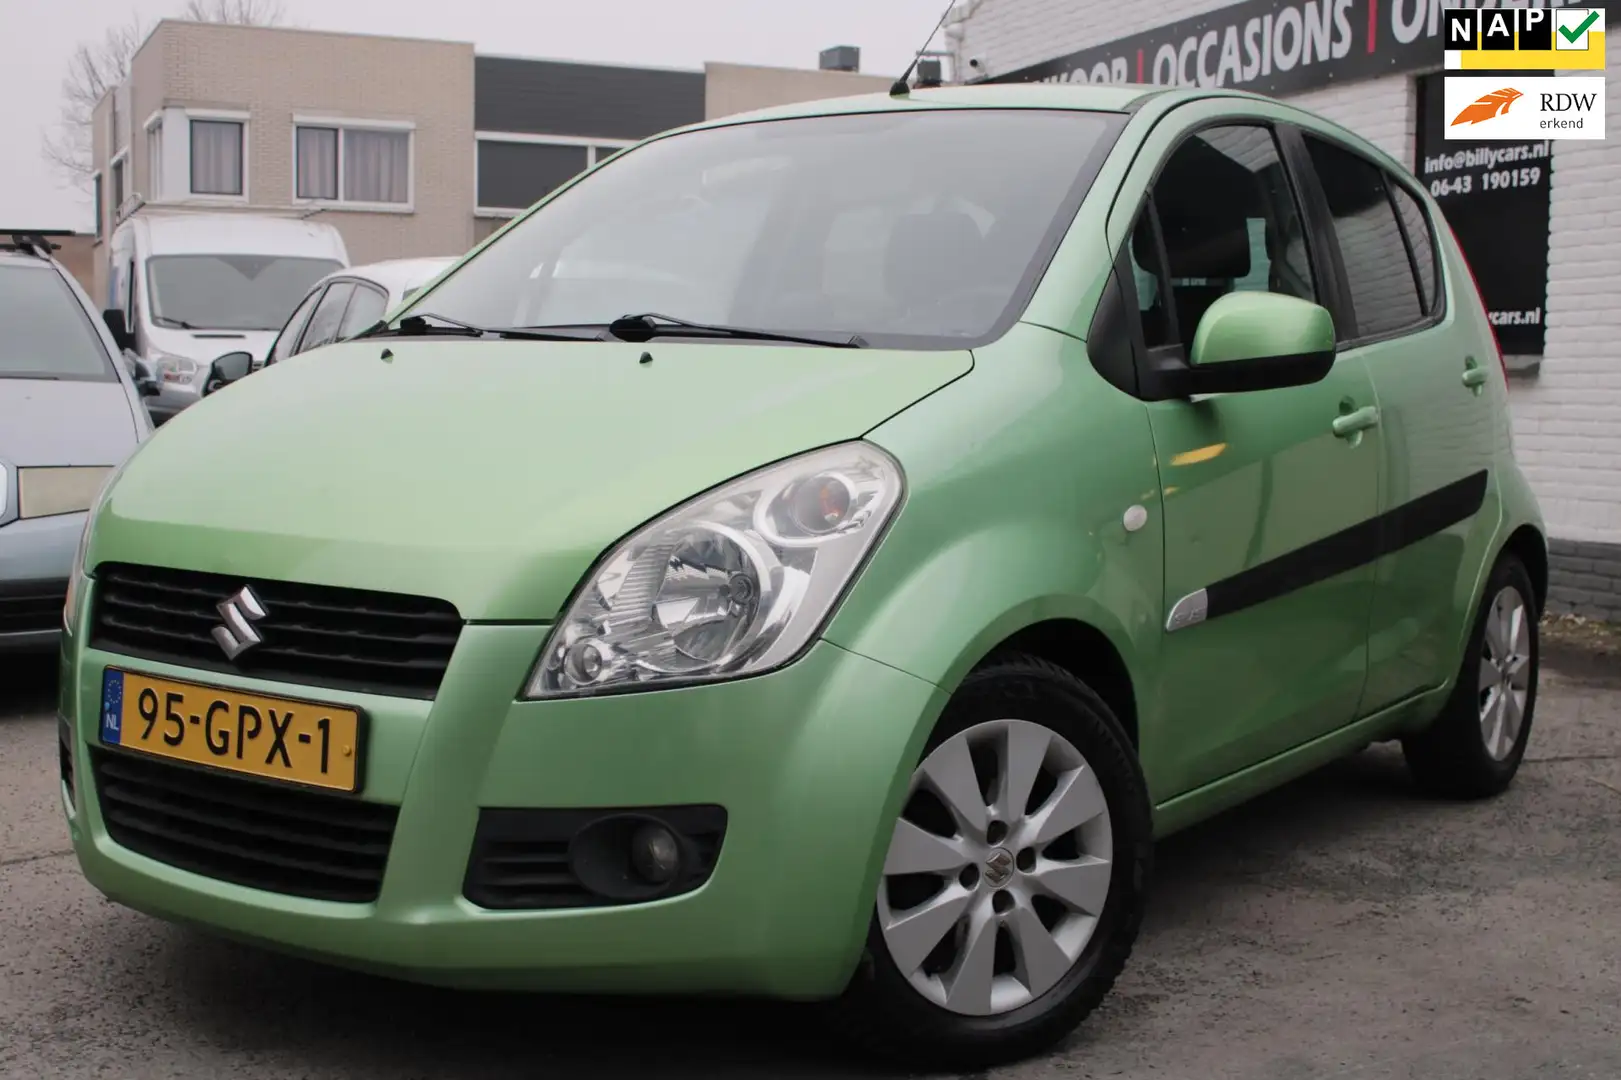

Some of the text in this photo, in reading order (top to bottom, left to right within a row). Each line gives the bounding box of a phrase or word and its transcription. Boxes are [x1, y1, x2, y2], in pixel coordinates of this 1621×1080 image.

[1153, 0, 1352, 88] OCCASIONS
[1424, 140, 1550, 174] info@billycars.nl
[1430, 167, 1541, 197] 06-43 190159
[105, 713, 120, 731] NL
[138, 687, 331, 774] 95-GPX-1
